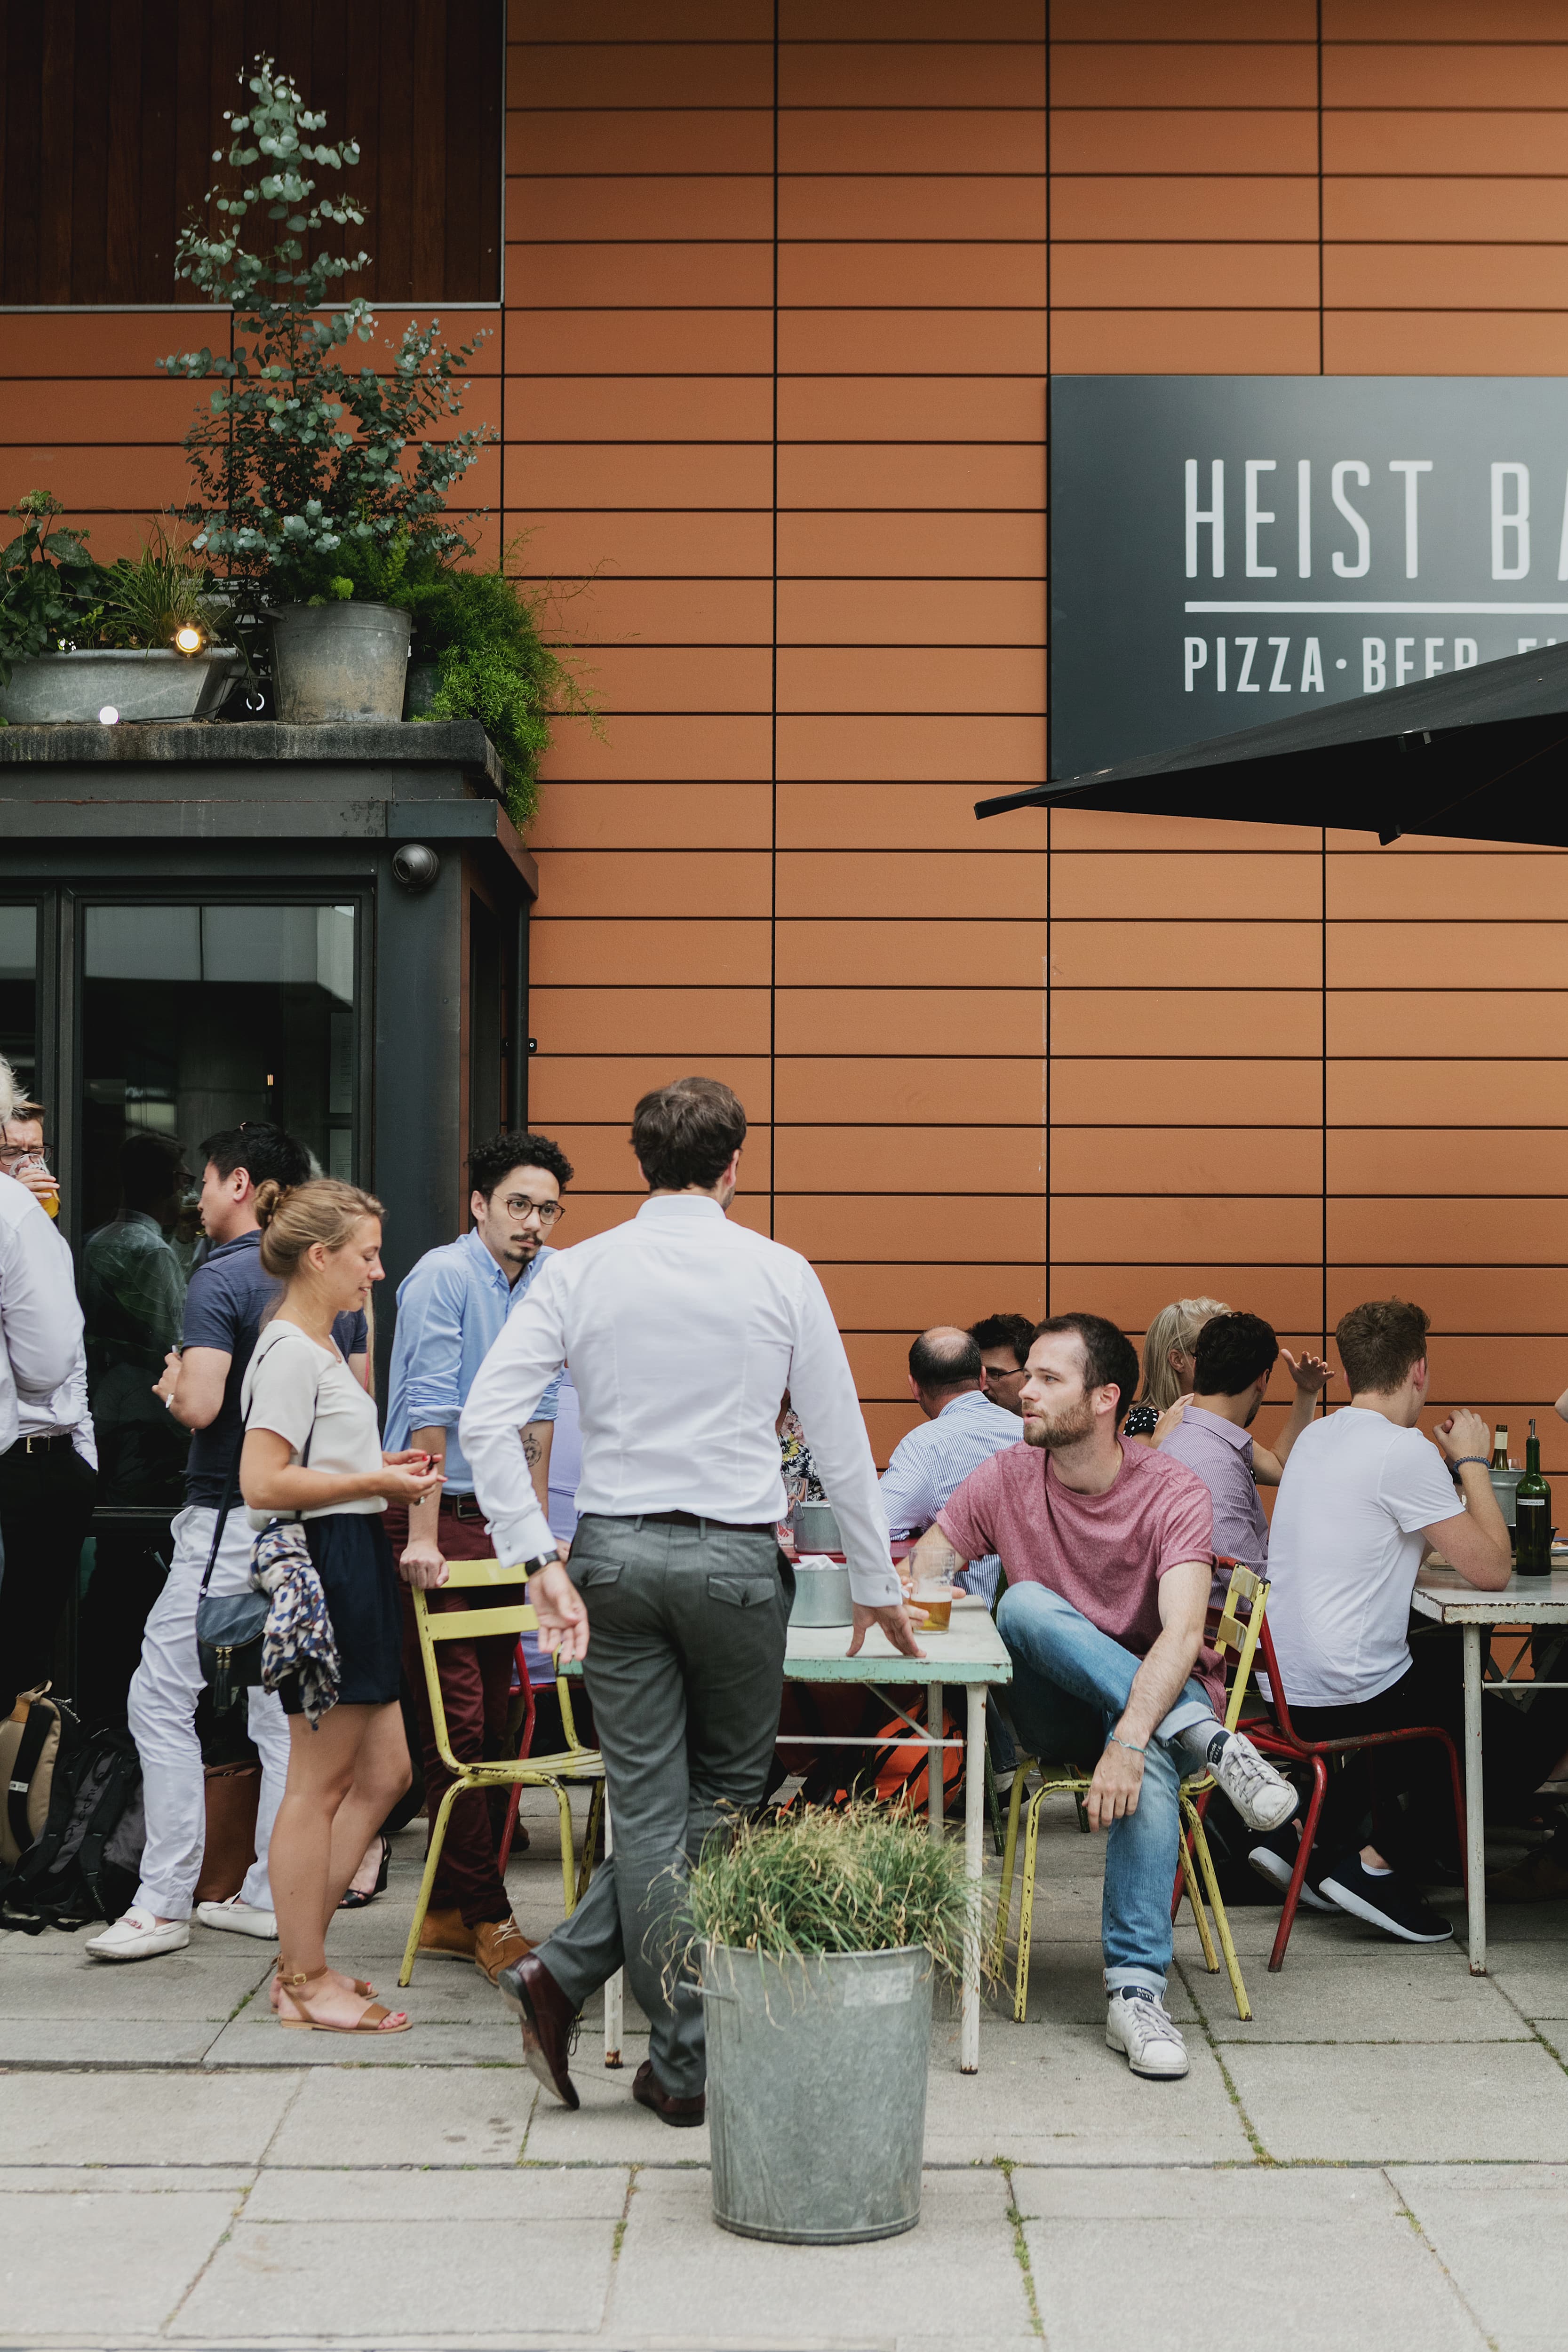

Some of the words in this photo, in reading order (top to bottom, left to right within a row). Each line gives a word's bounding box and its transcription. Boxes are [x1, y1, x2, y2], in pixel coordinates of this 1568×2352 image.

[1185, 459, 1433, 579] HEIST
[1490, 461, 1568, 581] B
[1184, 637, 1325, 692] PIZZA
